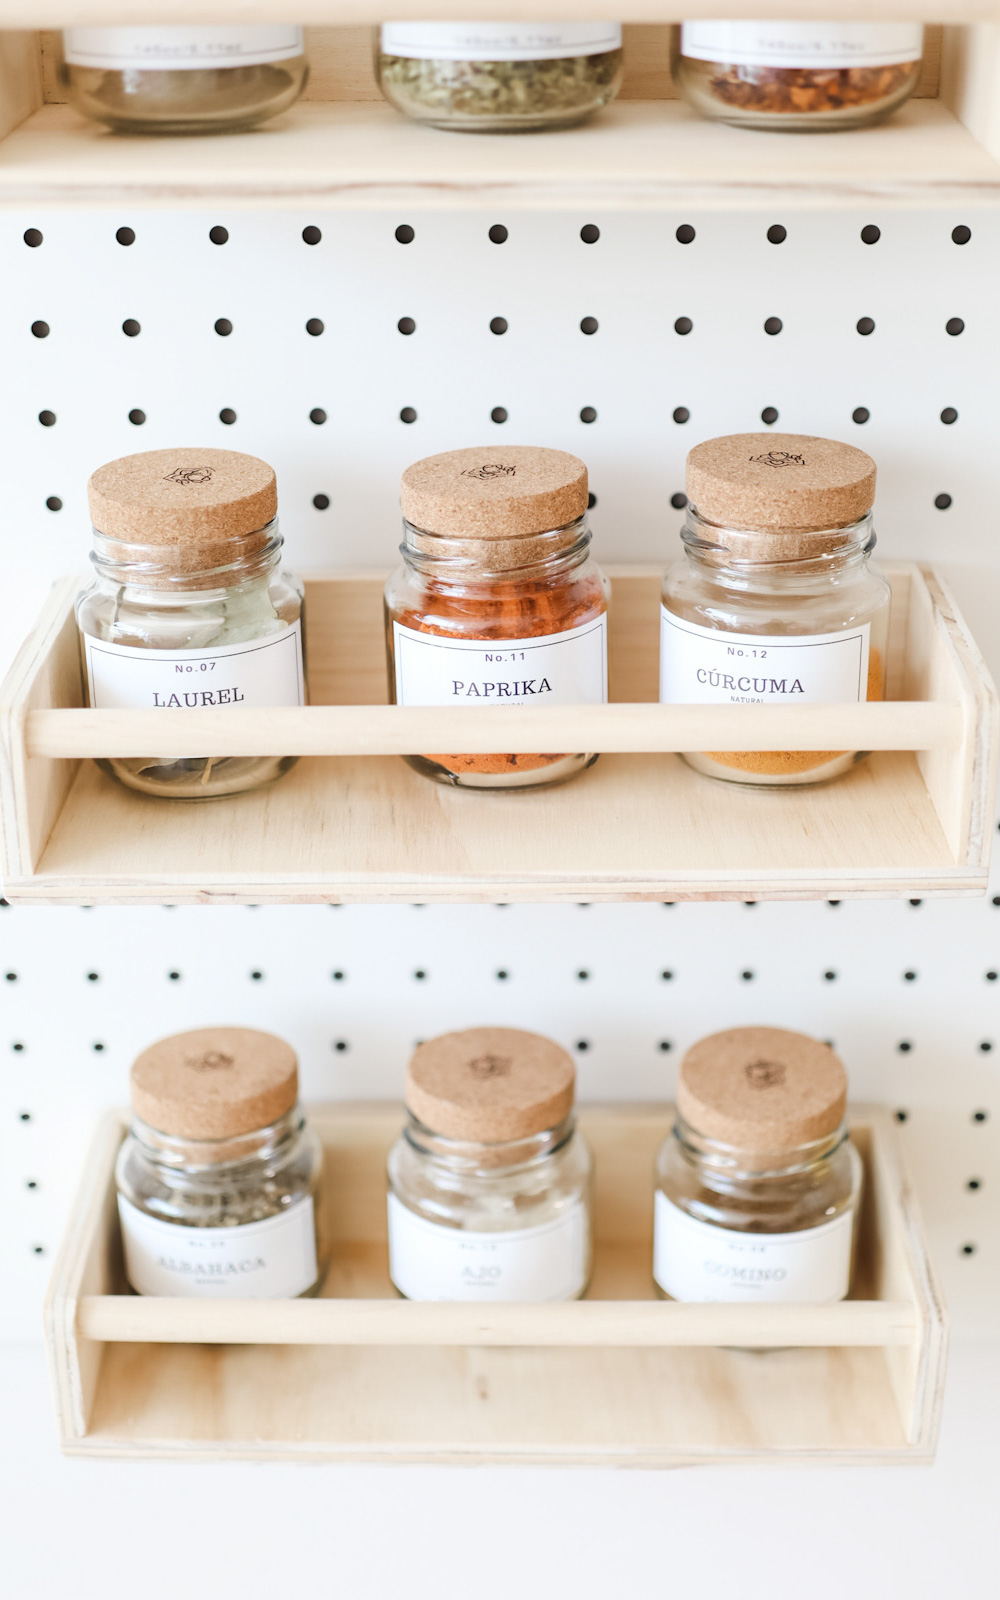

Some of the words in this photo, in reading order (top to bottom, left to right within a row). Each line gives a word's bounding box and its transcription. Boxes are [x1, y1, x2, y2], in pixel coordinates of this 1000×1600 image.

[485, 652, 525, 662] No.11
[727, 647, 768, 659] No.12
[175, 662, 216, 673] No.07
[451, 678, 553, 697] PAPRIKA
[696, 668, 805, 694] CÚRCUMA
[152, 687, 245, 707] LAUREL
